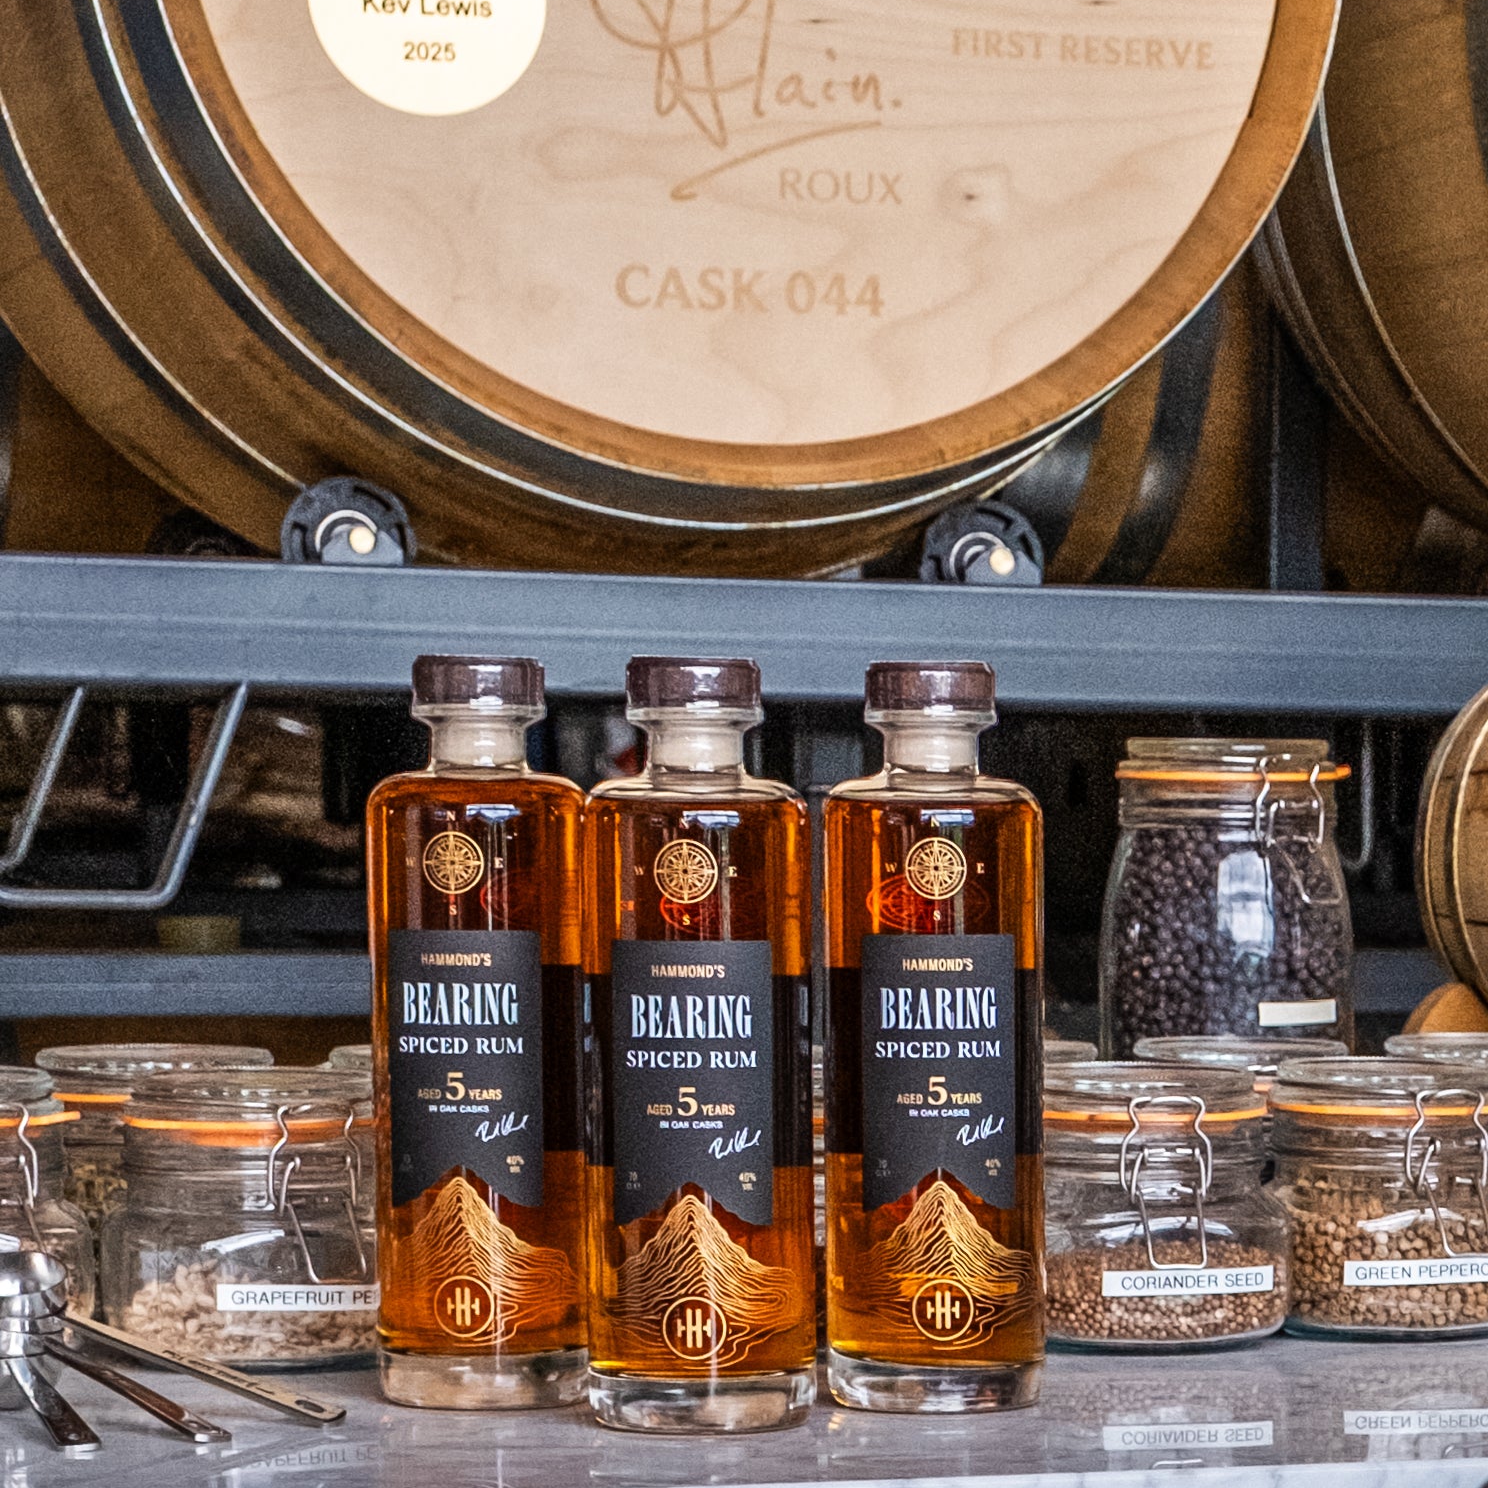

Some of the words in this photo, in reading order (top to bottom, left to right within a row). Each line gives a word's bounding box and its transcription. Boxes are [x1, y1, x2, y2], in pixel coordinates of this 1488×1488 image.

[404, 41, 457, 62] 2025
[951, 25, 1049, 60] FIRST
[1061, 31, 1214, 71] RESERVE
[777, 168, 903, 205] ROUX
[614, 263, 766, 315] CASK
[784, 271, 886, 319] 044
[420, 952, 492, 967] HAMMOND'S
[902, 958, 974, 972] HAMMOND'S
[651, 965, 726, 979] HAMMOND'S
[402, 981, 519, 1026] BEARING
[879, 986, 997, 1031] BEARING
[630, 993, 753, 1040] BEARING
[399, 1035, 469, 1055] SPICED
[475, 1036, 524, 1055] RUM
[874, 1041, 951, 1059] SPICED
[957, 1041, 1001, 1059] RUM
[626, 1050, 703, 1069] SPICED
[710, 1051, 758, 1069] RUM
[445, 1071, 466, 1101] 5
[469, 1088, 503, 1101] YEARS
[896, 1093, 924, 1105] AGED
[927, 1076, 948, 1105] 5
[950, 1092, 983, 1105] YEARS
[646, 1104, 673, 1116] AGED
[677, 1086, 699, 1117] 5
[701, 1103, 736, 1117] YEARS
[1121, 1275, 1218, 1291] CORIANDER
[1224, 1272, 1264, 1289] SEED
[1355, 1265, 1411, 1281] GREEN
[231, 1290, 346, 1306] GRAPEFRUIT
[352, 1291, 378, 1304] PE
